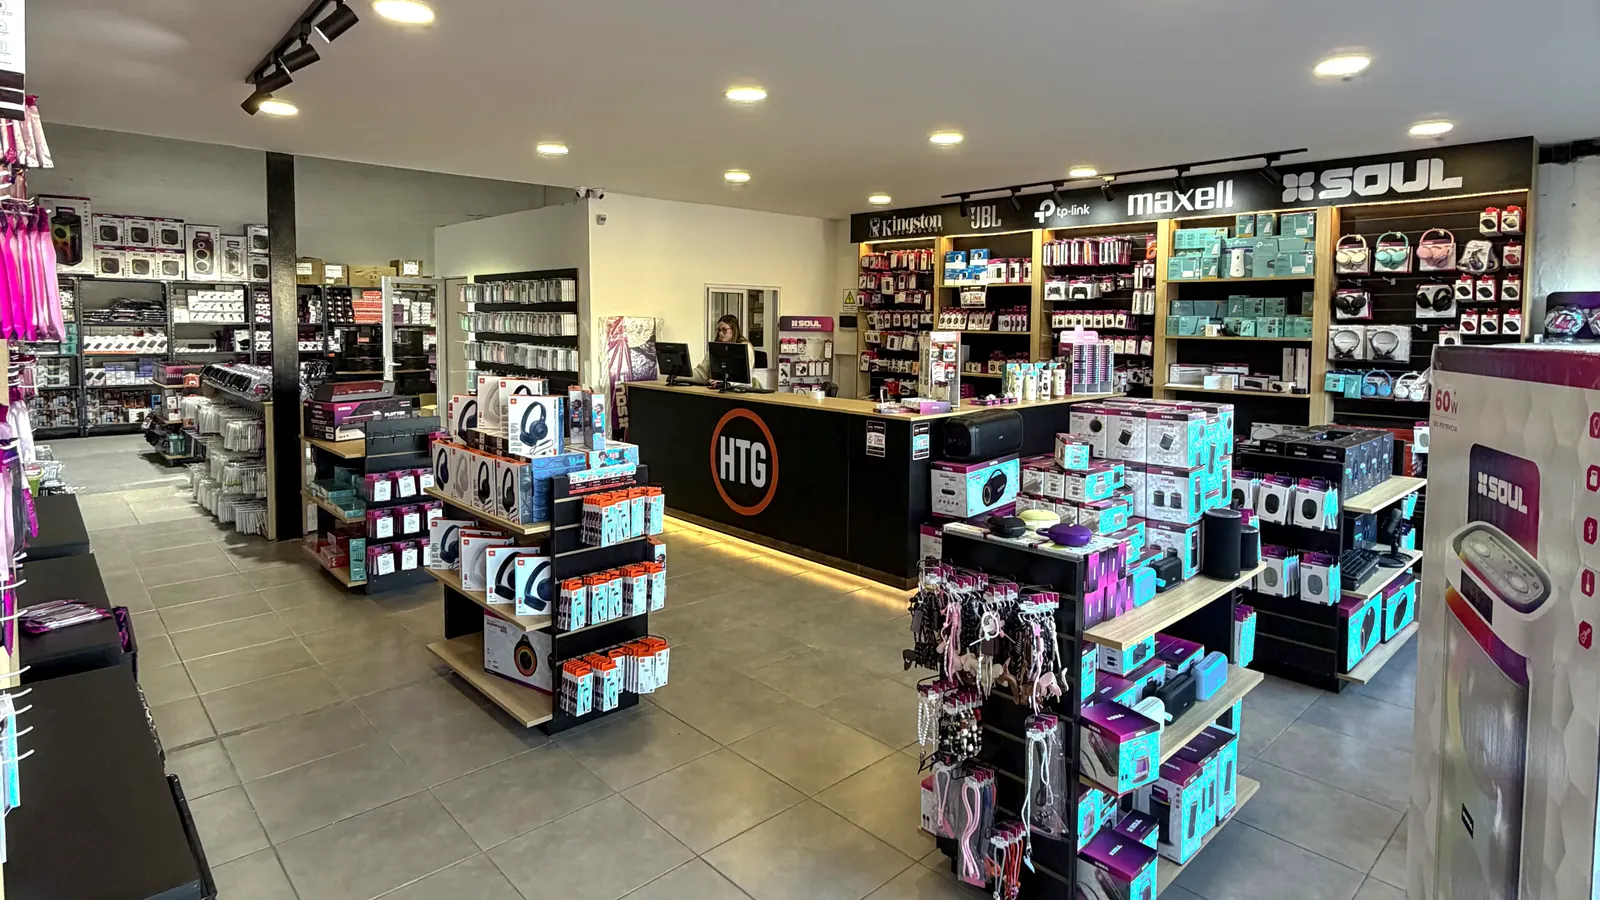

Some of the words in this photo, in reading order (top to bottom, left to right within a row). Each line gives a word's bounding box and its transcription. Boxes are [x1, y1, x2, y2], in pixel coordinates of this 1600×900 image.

[1318, 158, 1463, 200] SOUL
[1056, 204, 1090, 219] tp-link
[1127, 180, 1234, 216] maxell
[882, 213, 942, 236] Kingston
[971, 205, 1002, 229] JBL
[720, 435, 767, 488] HTG
[1488, 475, 1528, 515] SOUL
